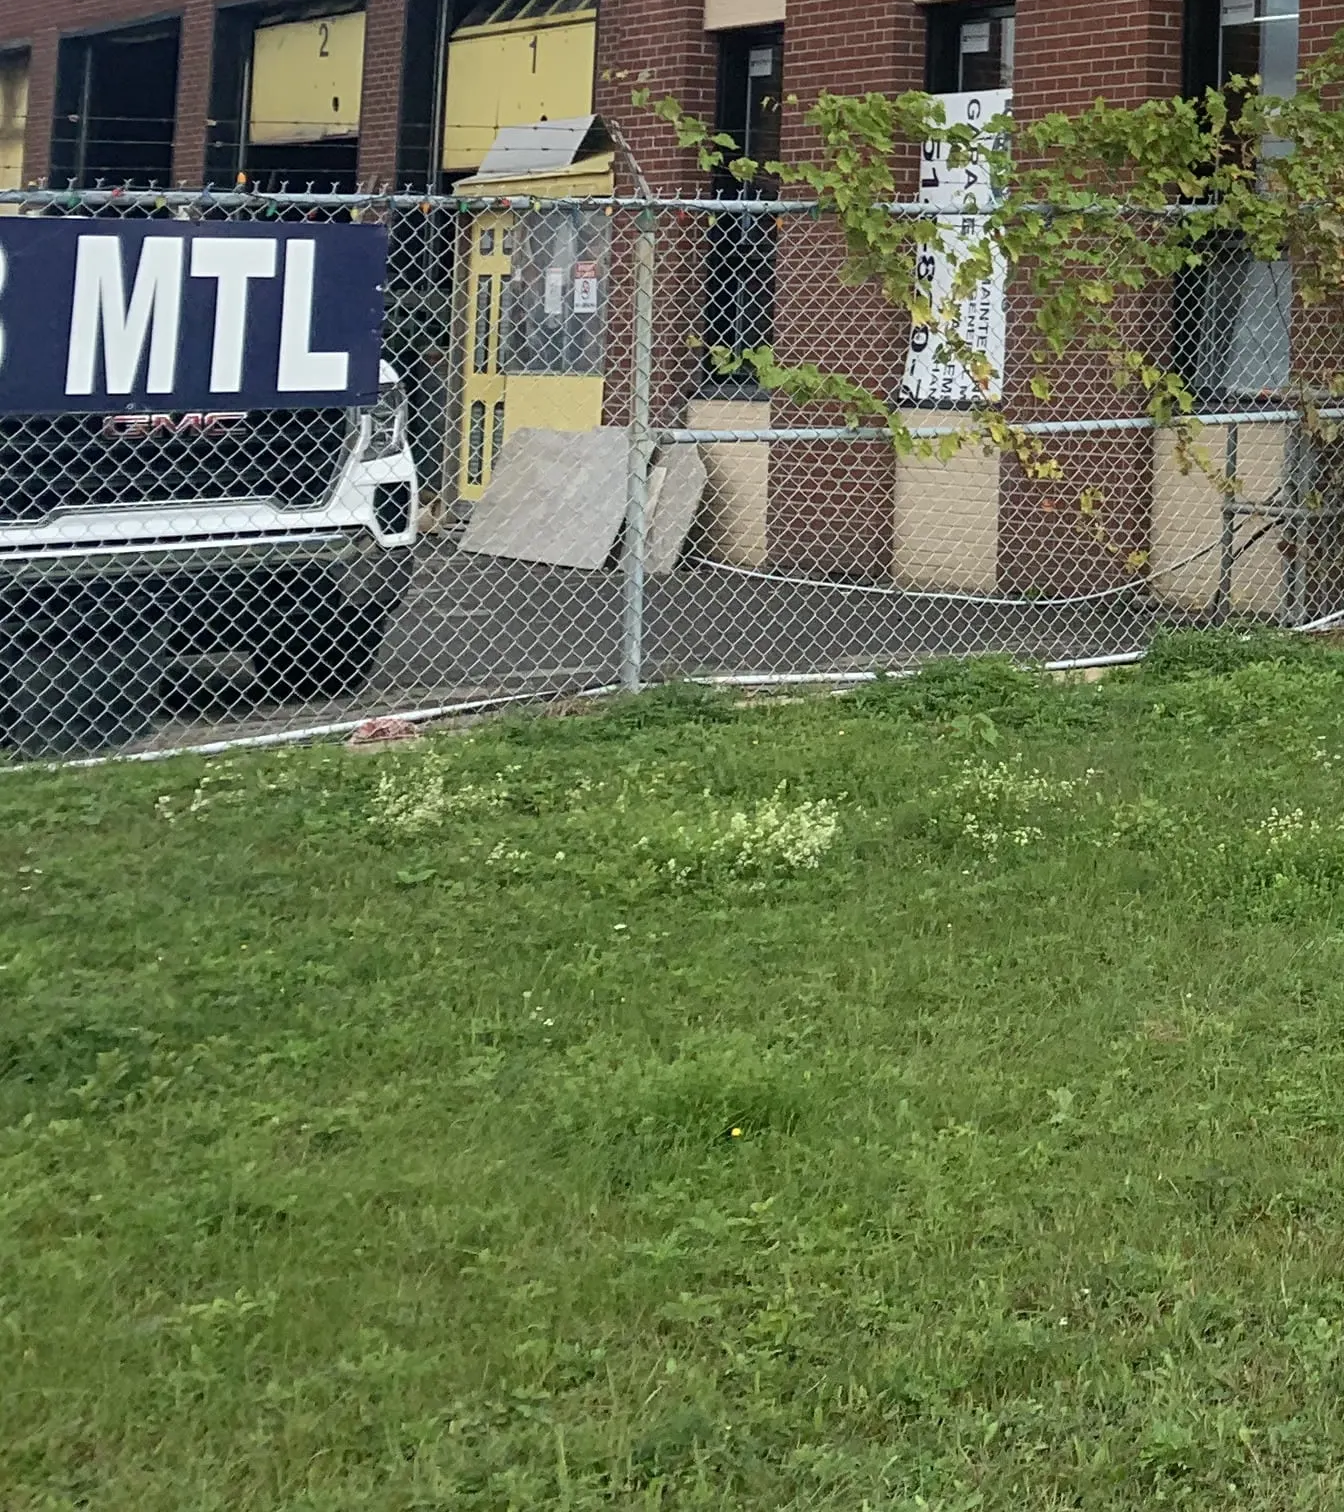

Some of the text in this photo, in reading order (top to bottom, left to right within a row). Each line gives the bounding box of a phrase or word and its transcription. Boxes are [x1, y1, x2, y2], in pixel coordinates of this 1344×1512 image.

[318, 22, 329, 57] 2
[528, 35, 537, 74] 1
[65, 235, 349, 395] MTL
[102, 412, 248, 440] GMC
